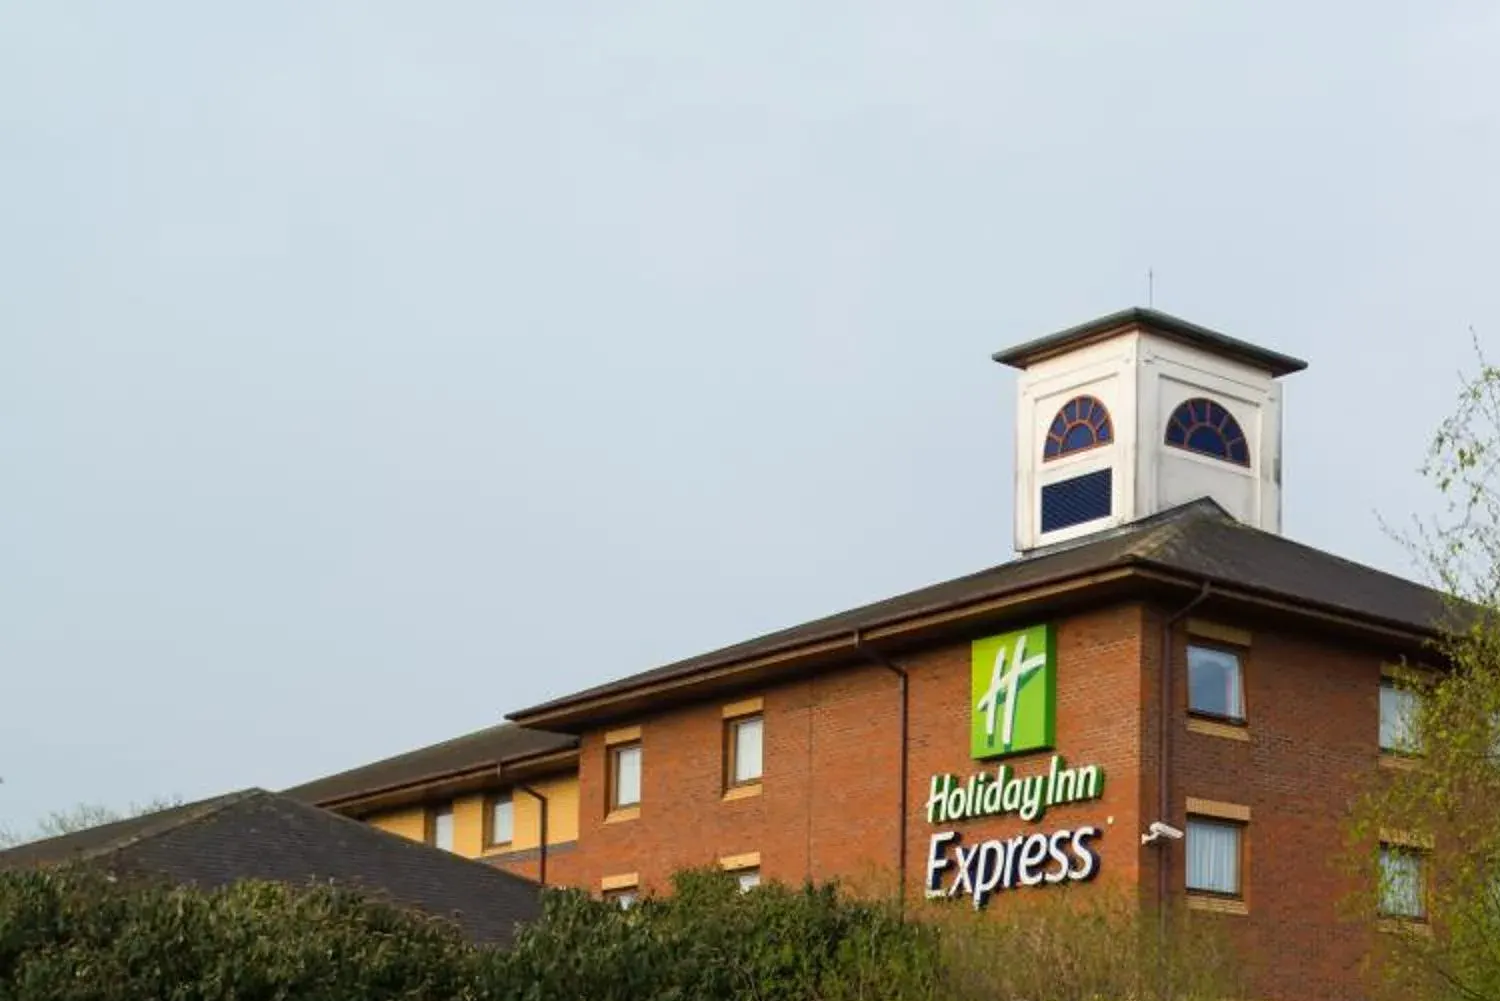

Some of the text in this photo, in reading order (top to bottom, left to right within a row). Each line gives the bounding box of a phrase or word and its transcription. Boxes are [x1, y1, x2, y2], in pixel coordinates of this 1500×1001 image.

[926, 755, 1100, 822] Holiday Inn
[925, 825, 1097, 910] Express
